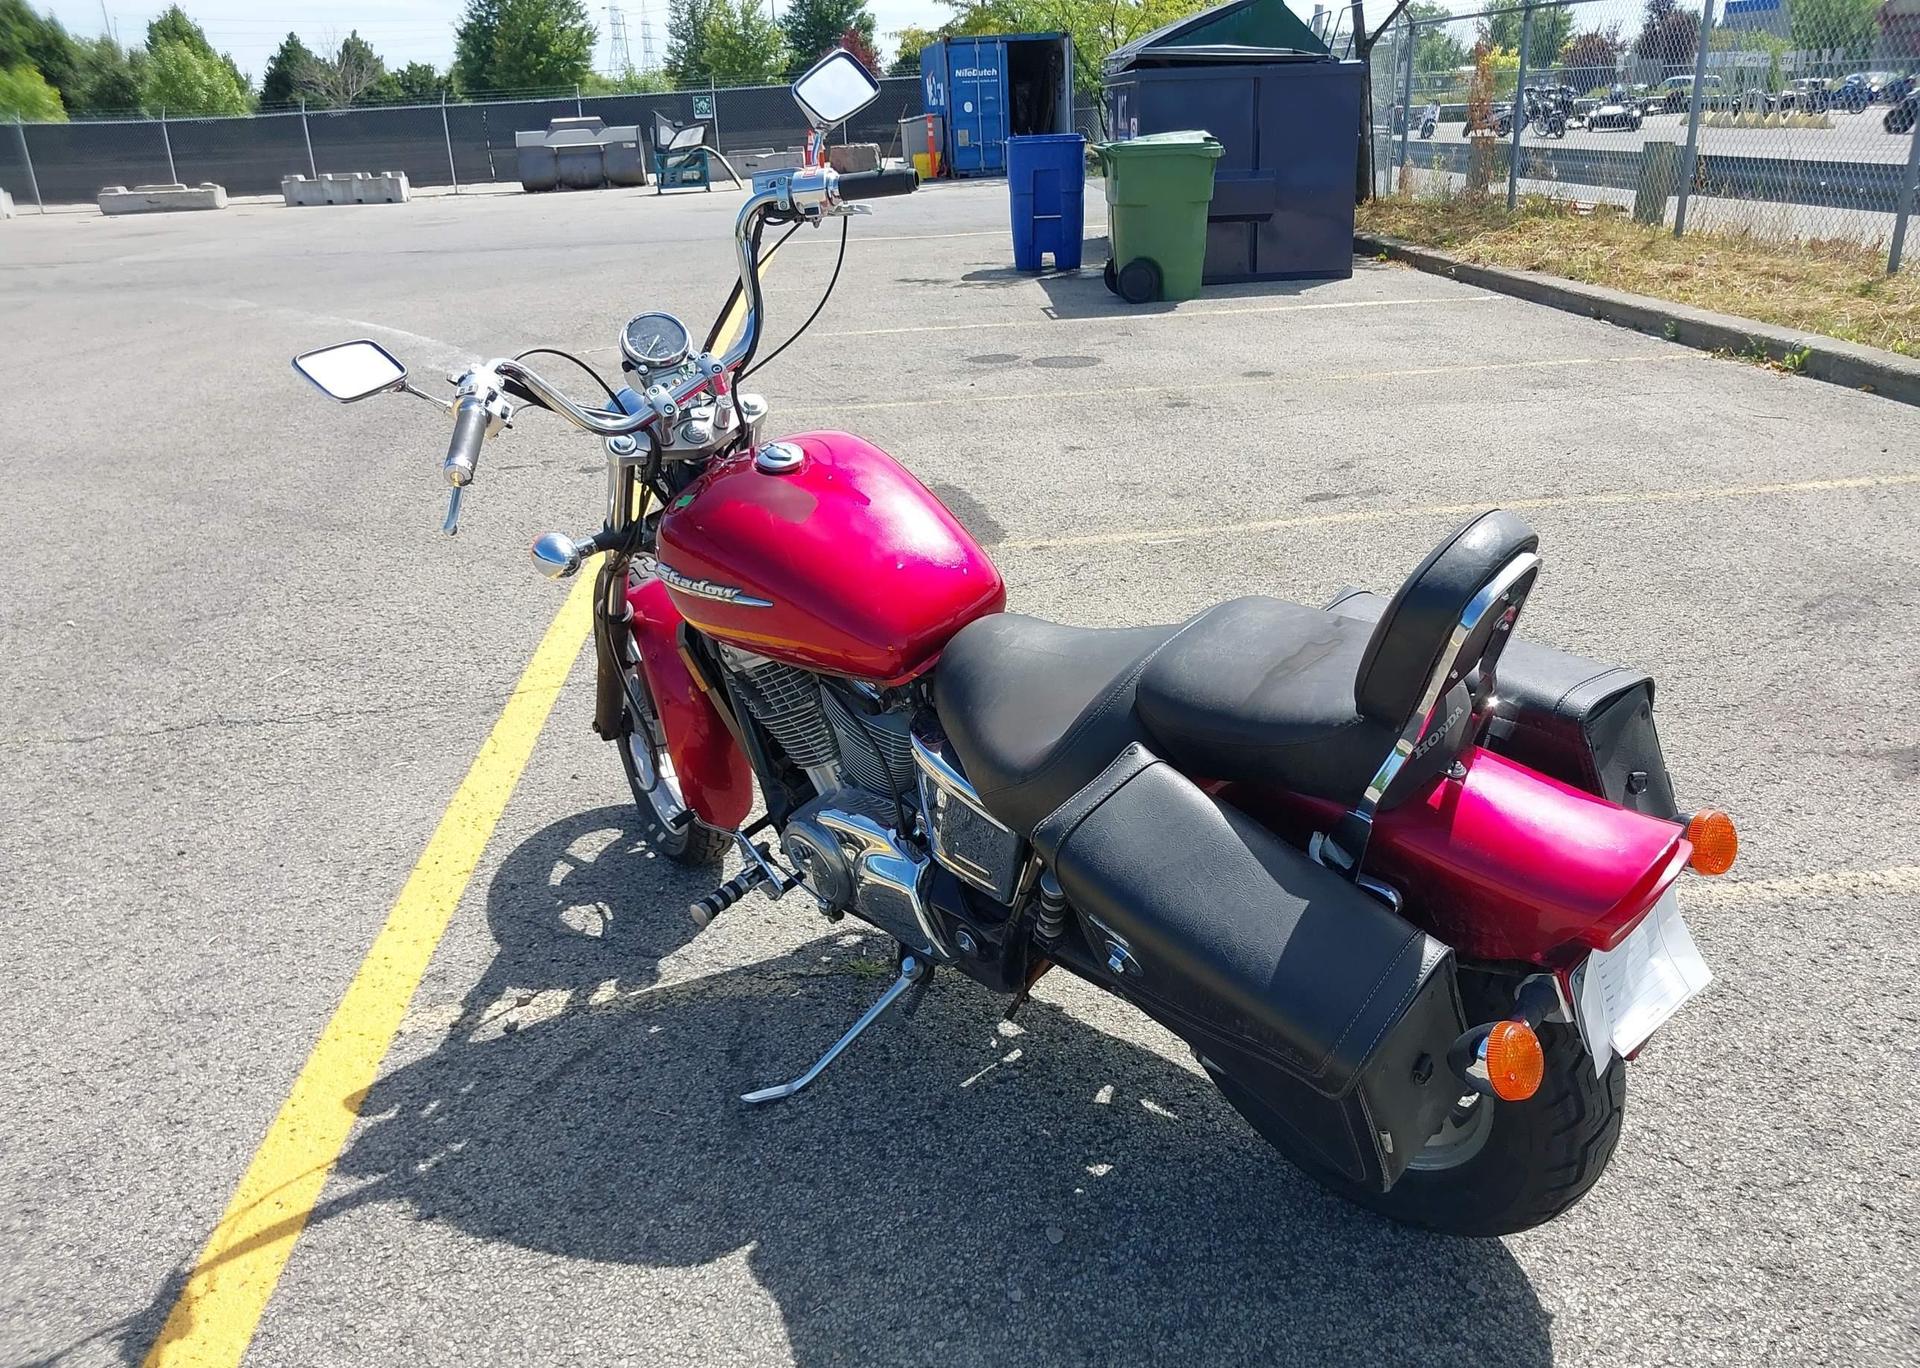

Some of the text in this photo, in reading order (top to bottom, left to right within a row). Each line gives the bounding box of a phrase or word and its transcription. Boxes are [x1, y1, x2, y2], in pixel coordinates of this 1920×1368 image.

[955, 68, 998, 78] NileDutch
[656, 562, 742, 598] Shadow
[1413, 706, 1464, 760] HONDA
